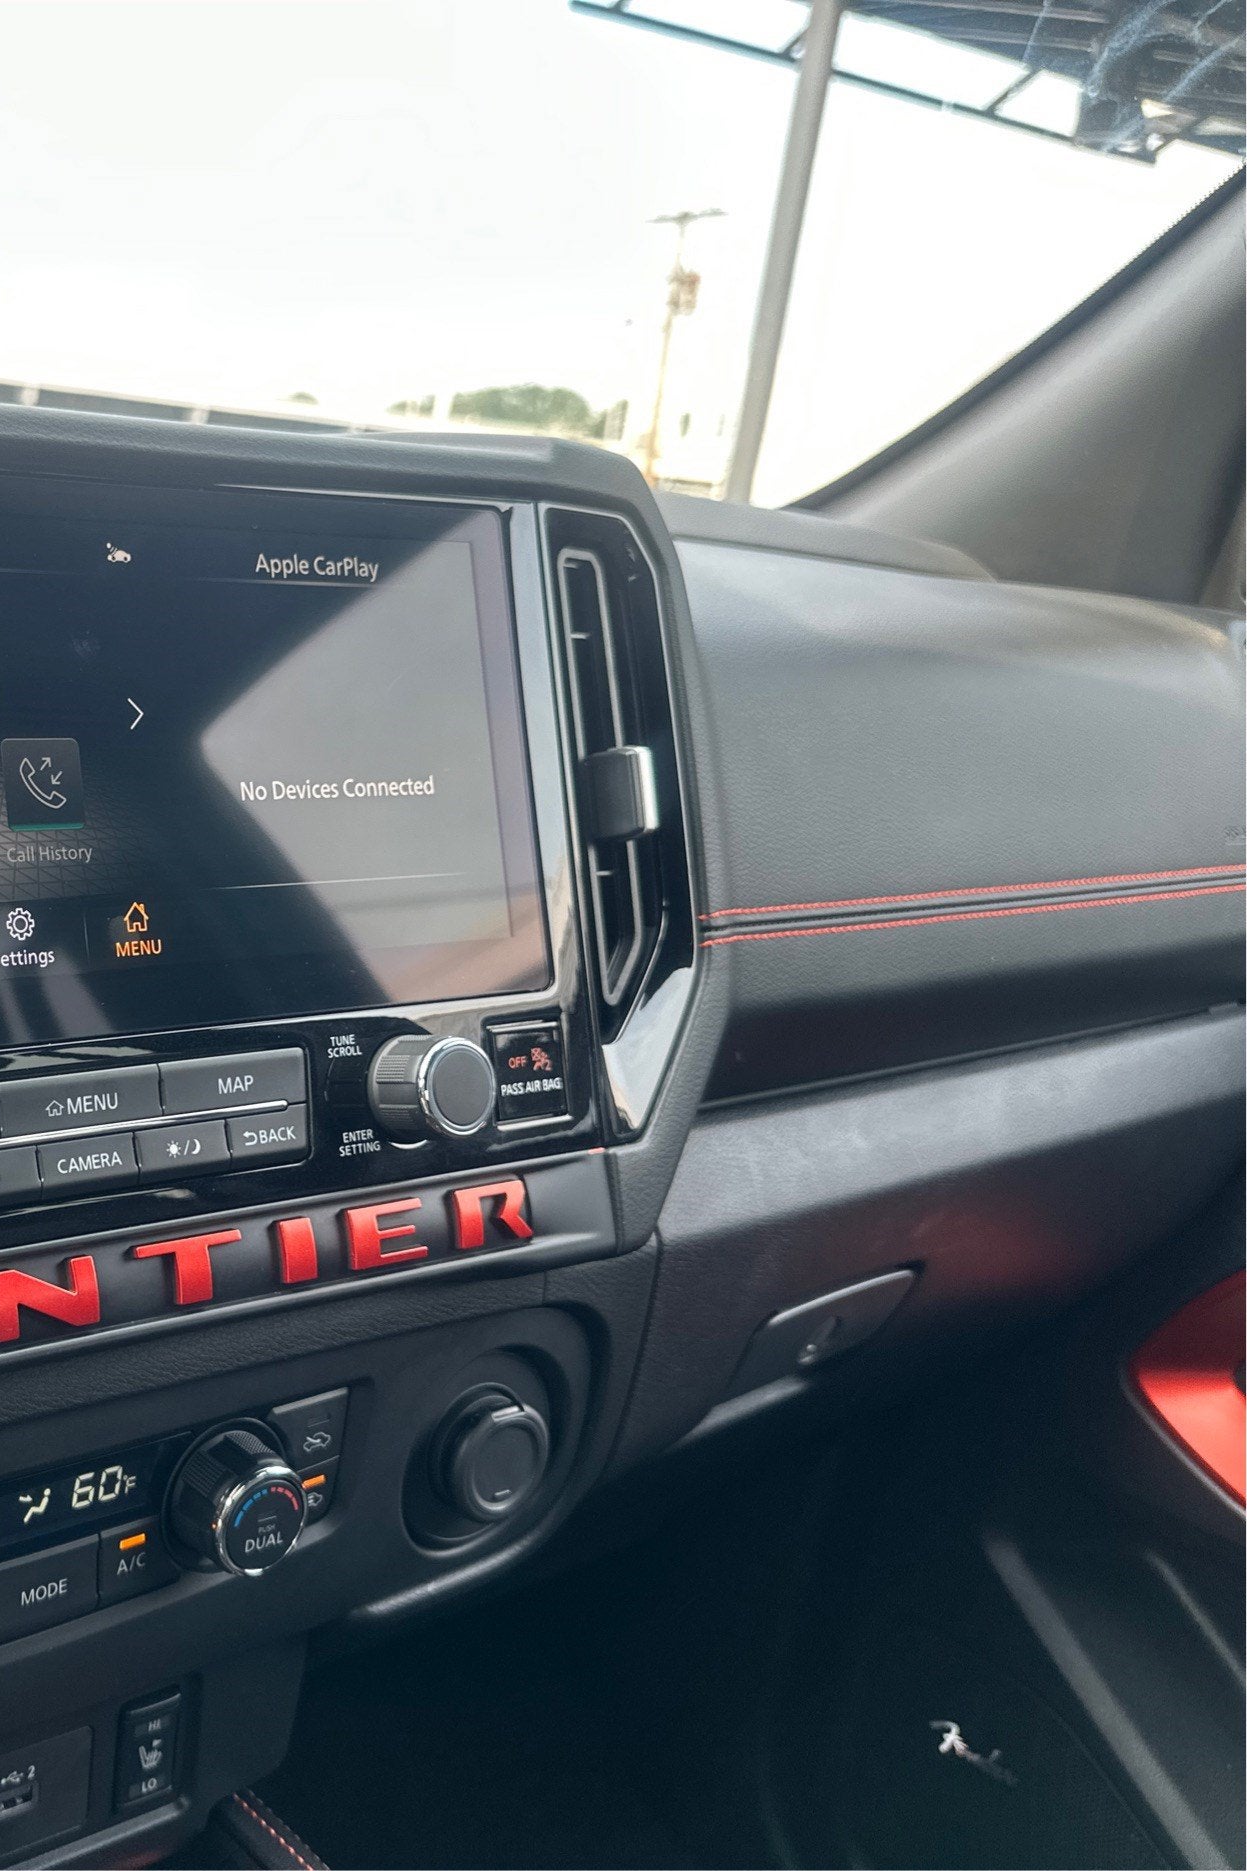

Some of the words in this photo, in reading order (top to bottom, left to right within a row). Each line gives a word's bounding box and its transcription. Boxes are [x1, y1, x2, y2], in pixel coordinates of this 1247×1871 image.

[255, 553, 309, 575] Apple
[313, 554, 379, 582] CarPlay
[240, 781, 267, 801] No
[272, 780, 339, 799] Devices
[343, 776, 435, 796] Connected
[7, 845, 35, 863] Call
[39, 844, 92, 863] History
[115, 940, 162, 957] MENU
[327, 1043, 362, 1057] SCROLL
[329, 1034, 356, 1047] TUNE
[508, 1056, 527, 1069] OFF
[217, 1074, 254, 1095] MAP
[501, 1082, 525, 1097] PASS
[526, 1080, 541, 1093] AIR
[542, 1077, 563, 1091] BAG
[66, 1093, 120, 1115] MENU
[259, 1125, 296, 1144] BACK
[341, 1129, 374, 1144] ENTER
[339, 1139, 382, 1157] SETTING
[57, 1151, 123, 1174] CAMERA
[244, 1531, 284, 1553] DUAL
[116, 1552, 147, 1576] A/C
[20, 1577, 69, 1606] MODE
[27, 1765, 36, 1779] 2
[141, 1777, 158, 1794] LO
